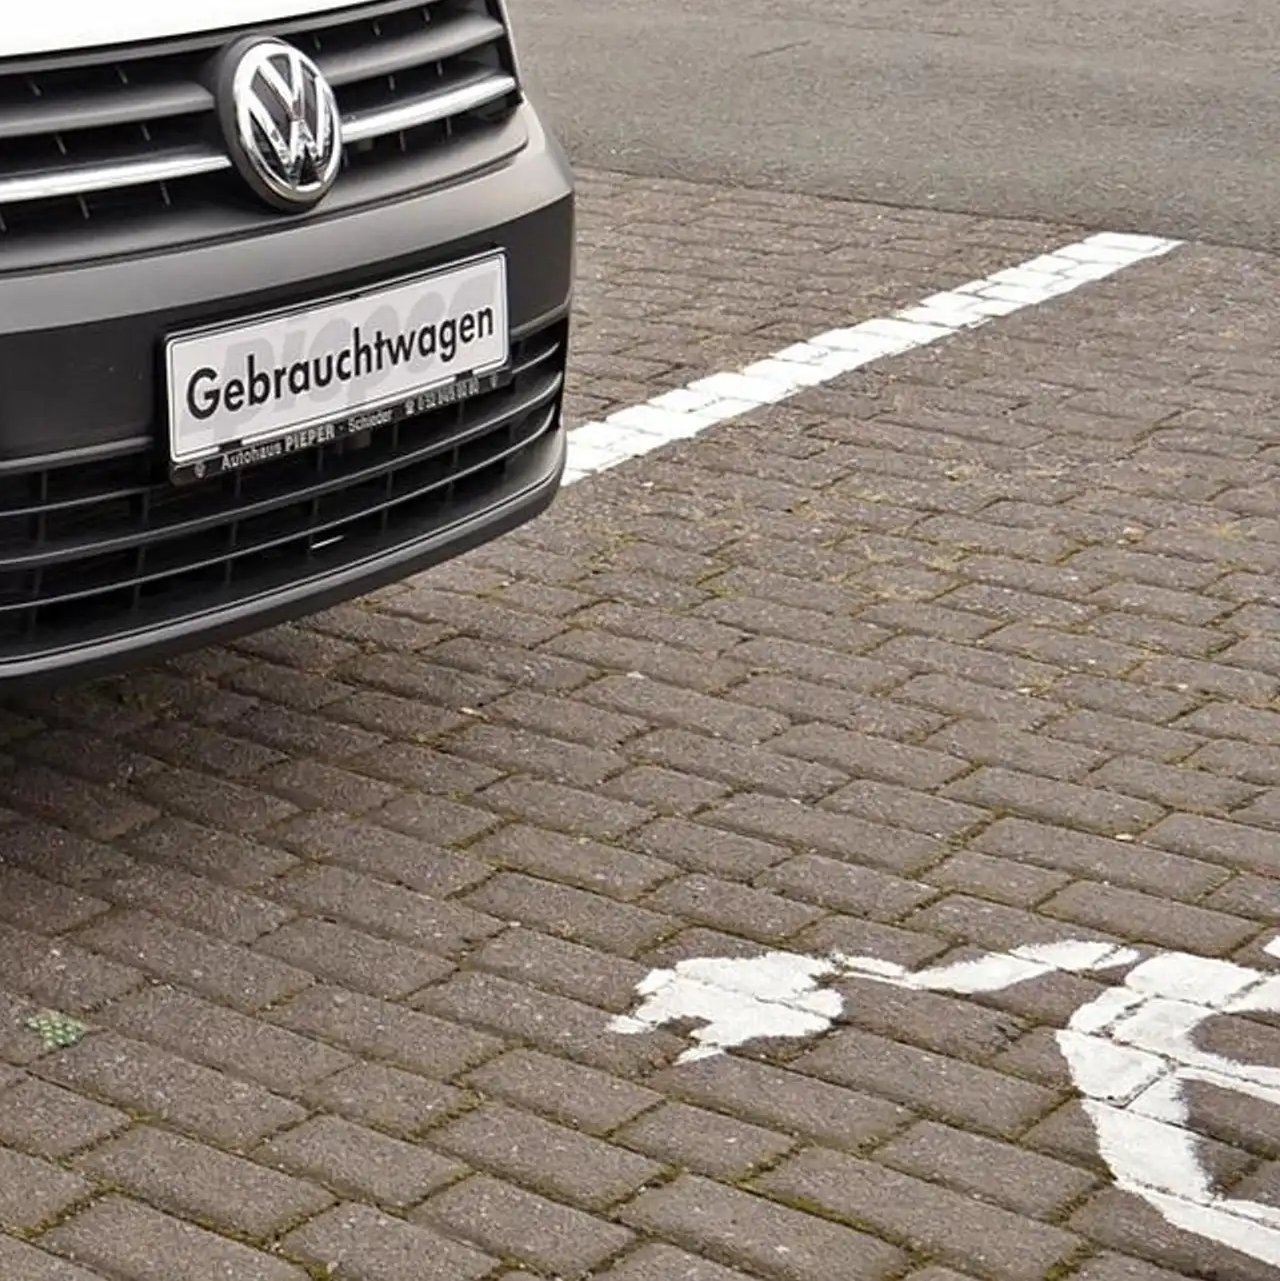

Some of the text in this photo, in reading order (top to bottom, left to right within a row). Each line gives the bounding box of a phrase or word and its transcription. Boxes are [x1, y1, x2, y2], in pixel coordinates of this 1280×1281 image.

[186, 305, 494, 421] Gebrauchtwagen
[221, 441, 282, 471] Autohaus
[285, 422, 336, 453] PIEPER
